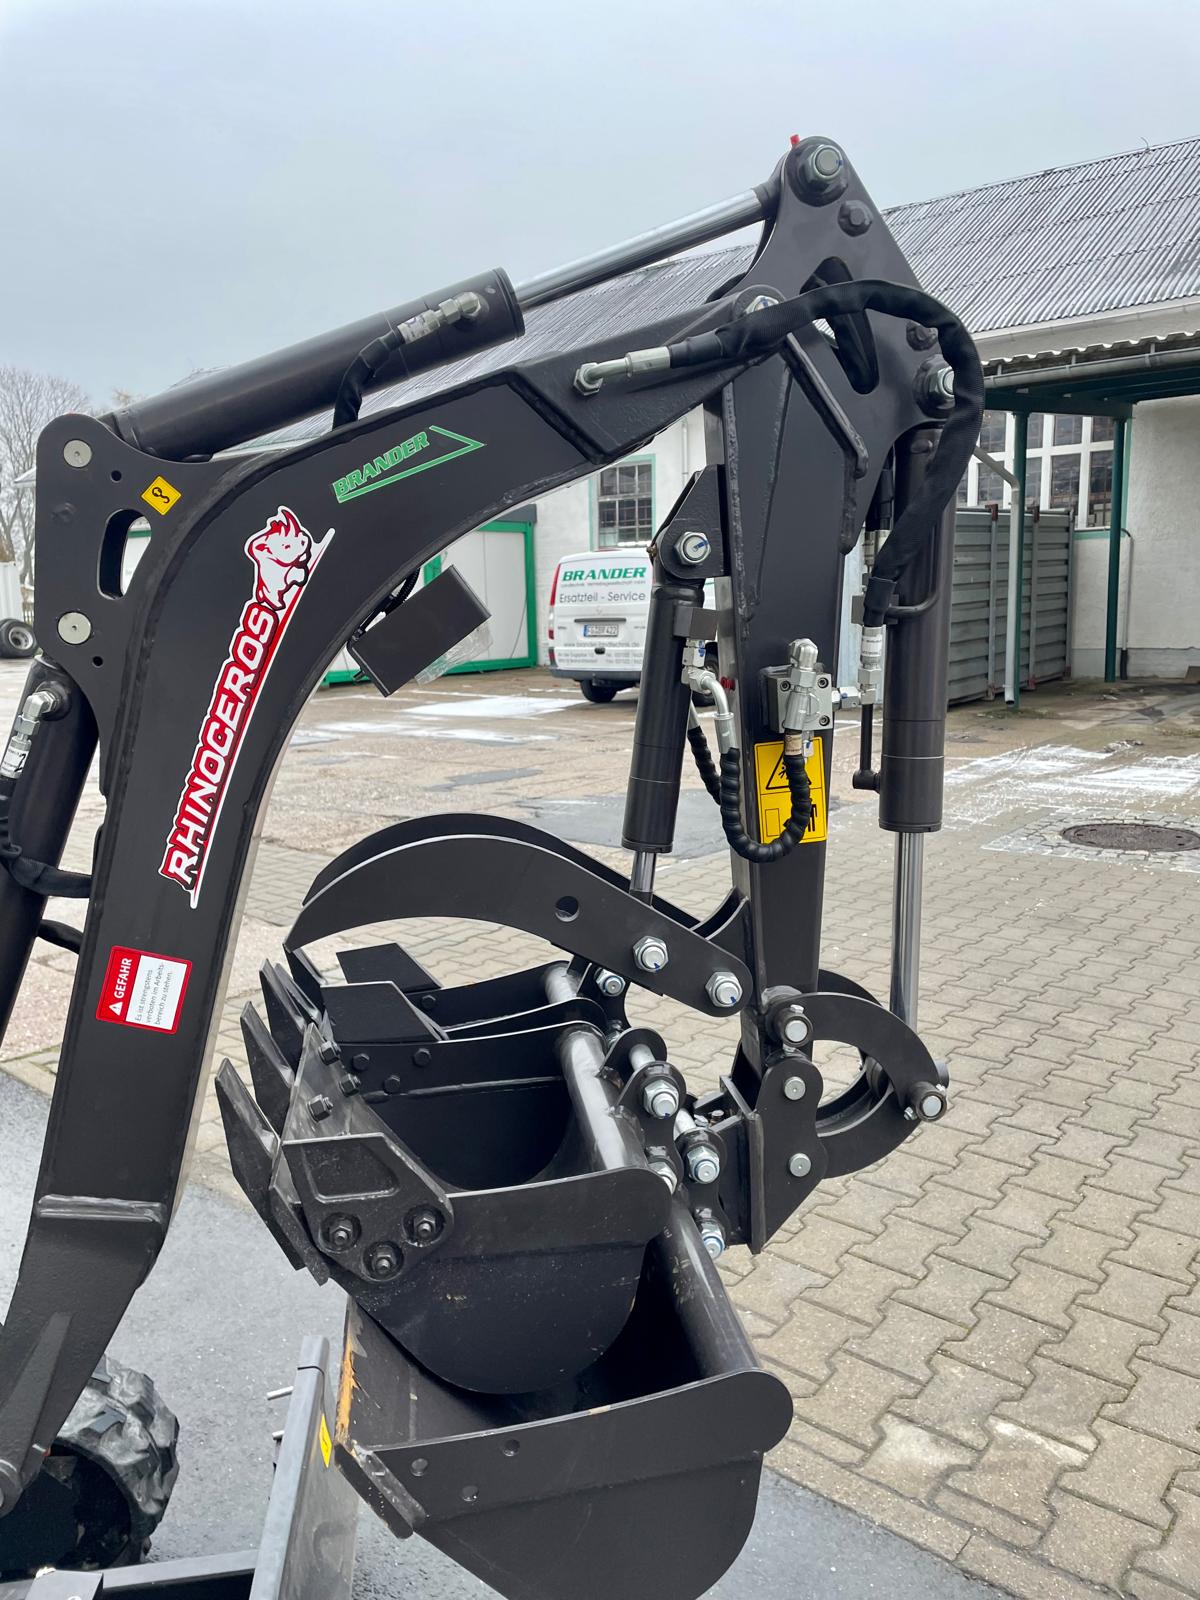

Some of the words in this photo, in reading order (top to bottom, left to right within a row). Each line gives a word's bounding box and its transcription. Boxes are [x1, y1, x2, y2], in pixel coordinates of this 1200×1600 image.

[332, 431, 430, 497] BRANDER
[562, 567, 647, 581] BRANDER
[559, 591, 598, 603] Ersatzteil
[607, 591, 646, 602] Service
[166, 604, 277, 885] RHINOCEROS
[114, 957, 132, 999] GEFAHR
[146, 995, 157, 1023] verboten
[155, 1002, 165, 1025] bereich
